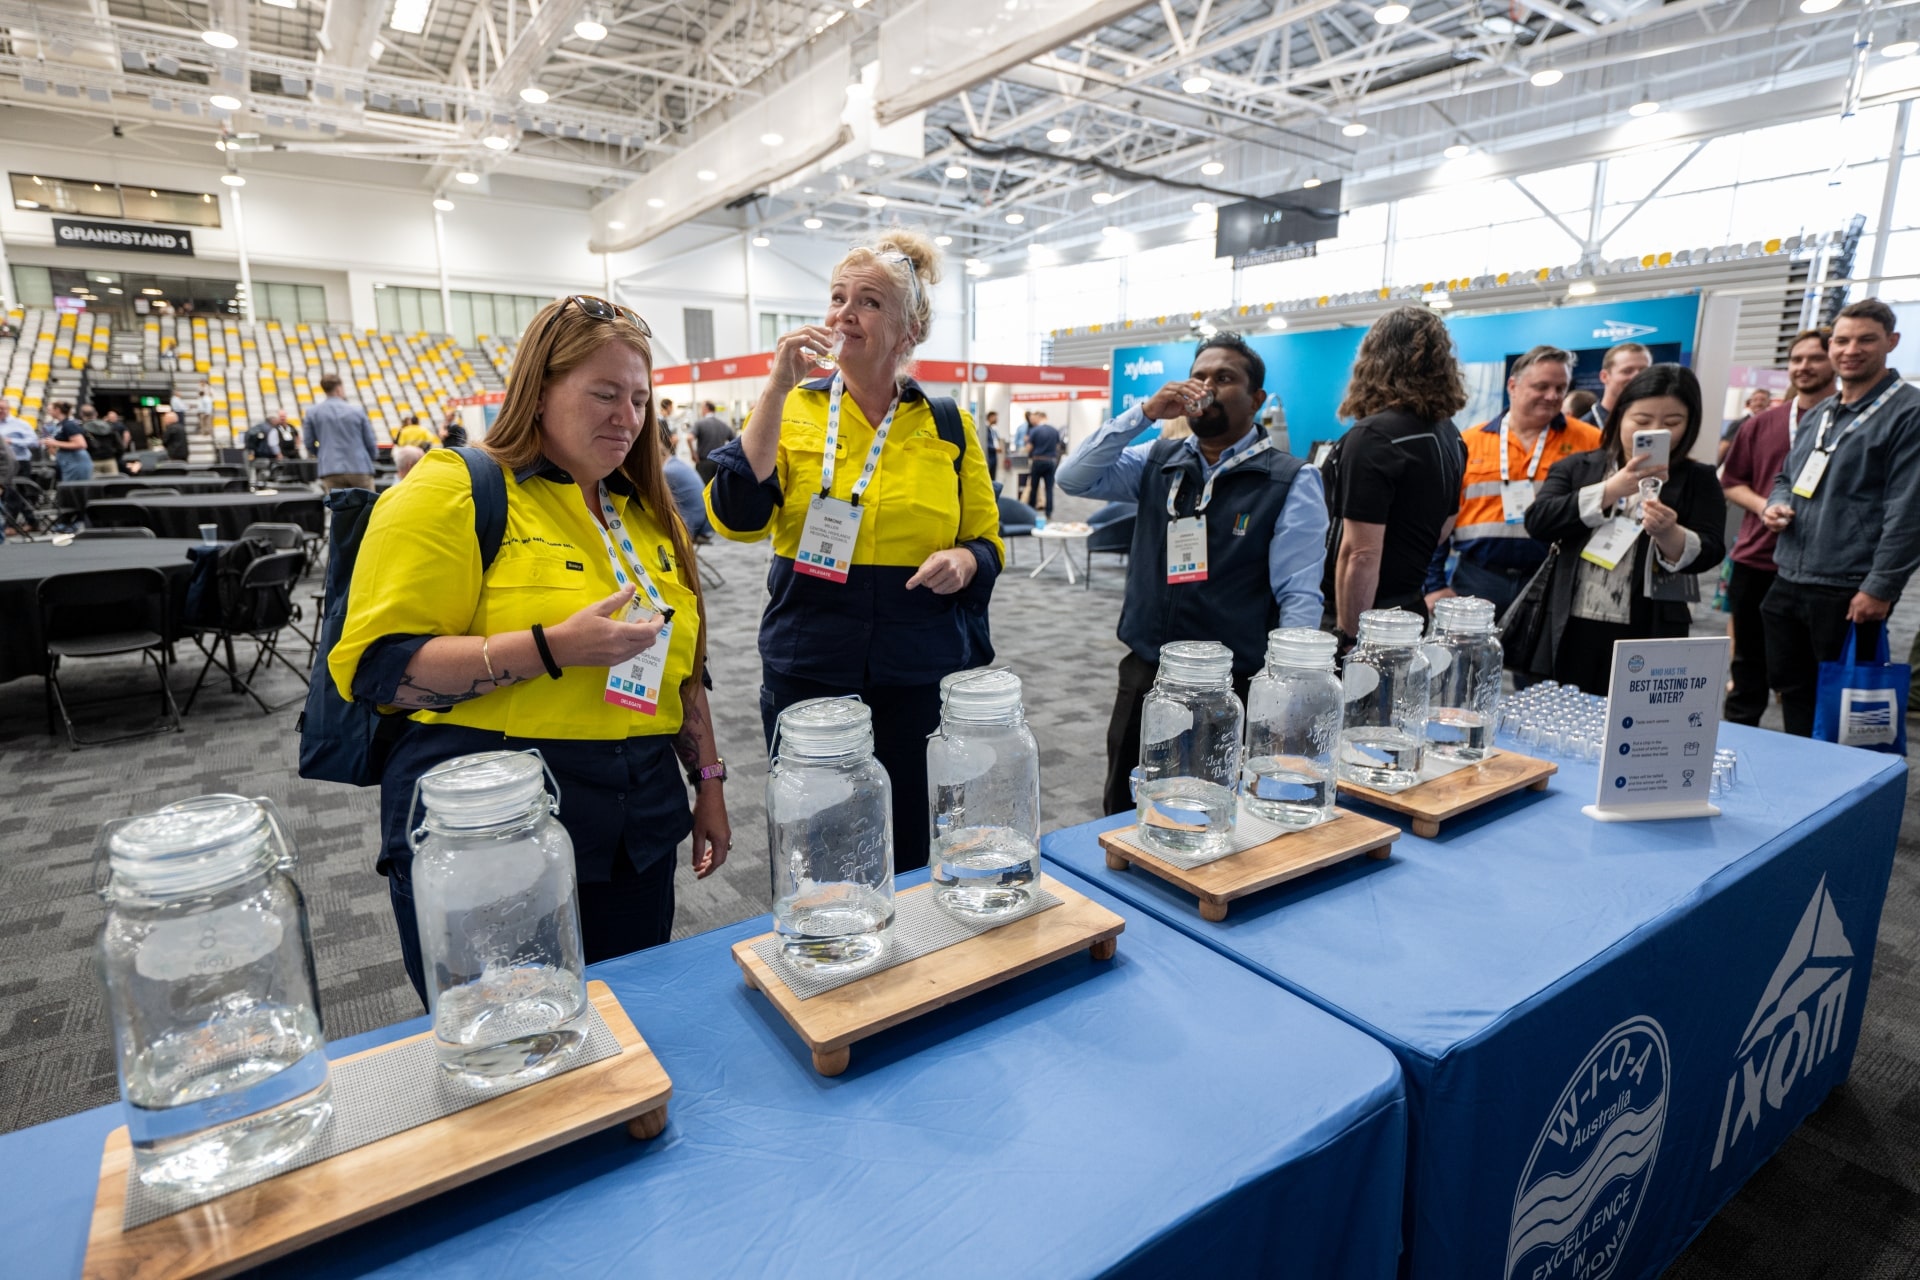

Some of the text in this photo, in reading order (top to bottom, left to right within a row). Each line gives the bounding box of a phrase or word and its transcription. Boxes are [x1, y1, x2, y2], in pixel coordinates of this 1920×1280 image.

[59, 225, 189, 250] GRANDSTAND 1
[1234, 246, 1305, 269] GRANDSTAND
[1123, 356, 1164, 381] xylem
[809, 568, 831, 577] DELEGATE
[1650, 666, 1688, 677] WHO HAS THE
[1629, 677, 1707, 693] BEST TASTING TAP
[620, 698, 642, 709] DELEGATE
[1649, 690, 1684, 705] WATER?
[1569, 1088, 1632, 1154] Australia
[1532, 1182, 1632, 1280] EXCELLENCE
[1572, 1247, 1588, 1278] IN
